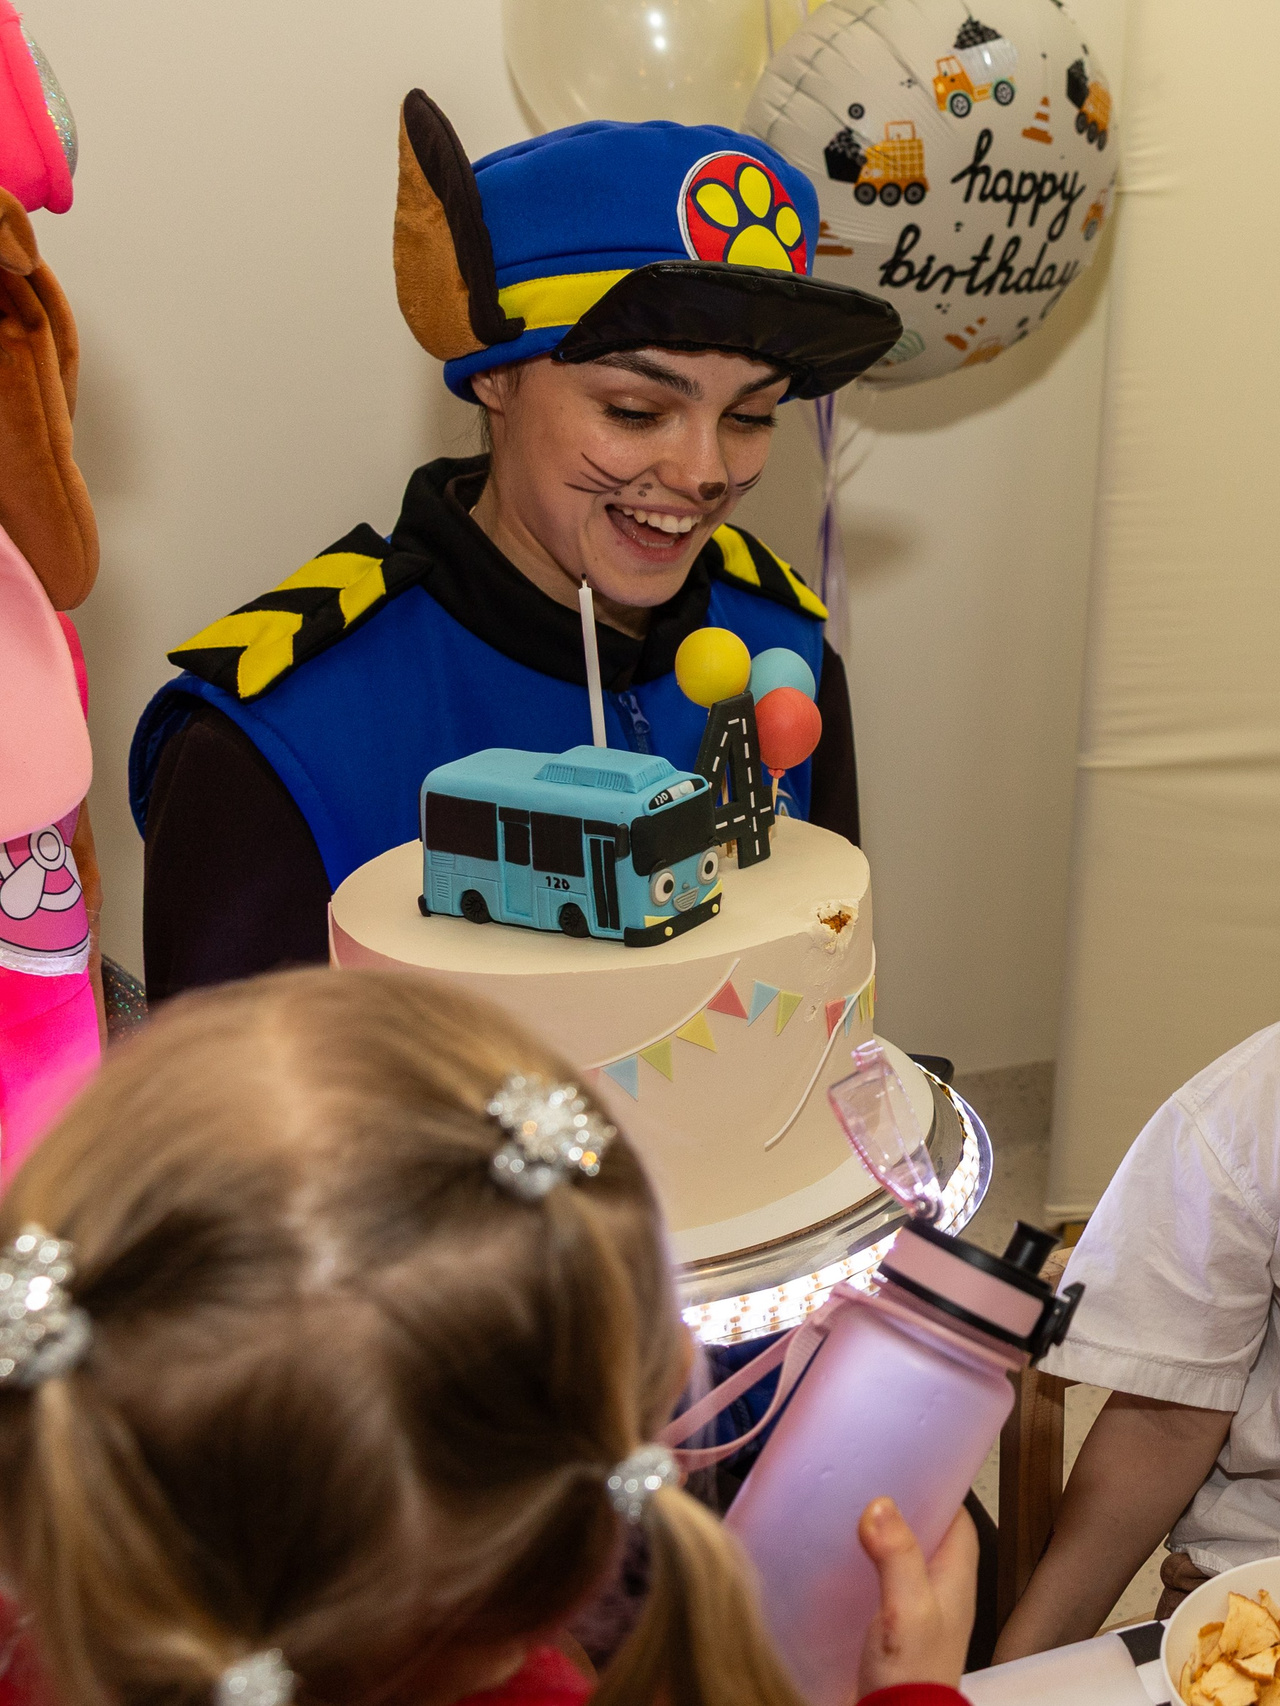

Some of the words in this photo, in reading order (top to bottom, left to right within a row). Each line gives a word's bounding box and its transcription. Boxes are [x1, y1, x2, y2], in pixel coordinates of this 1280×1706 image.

[951, 128, 1087, 242] happy
[879, 223, 1080, 320] birthday
[654, 792, 669, 806] 120
[694, 690, 776, 870] 4
[545, 876, 571, 890] 120
